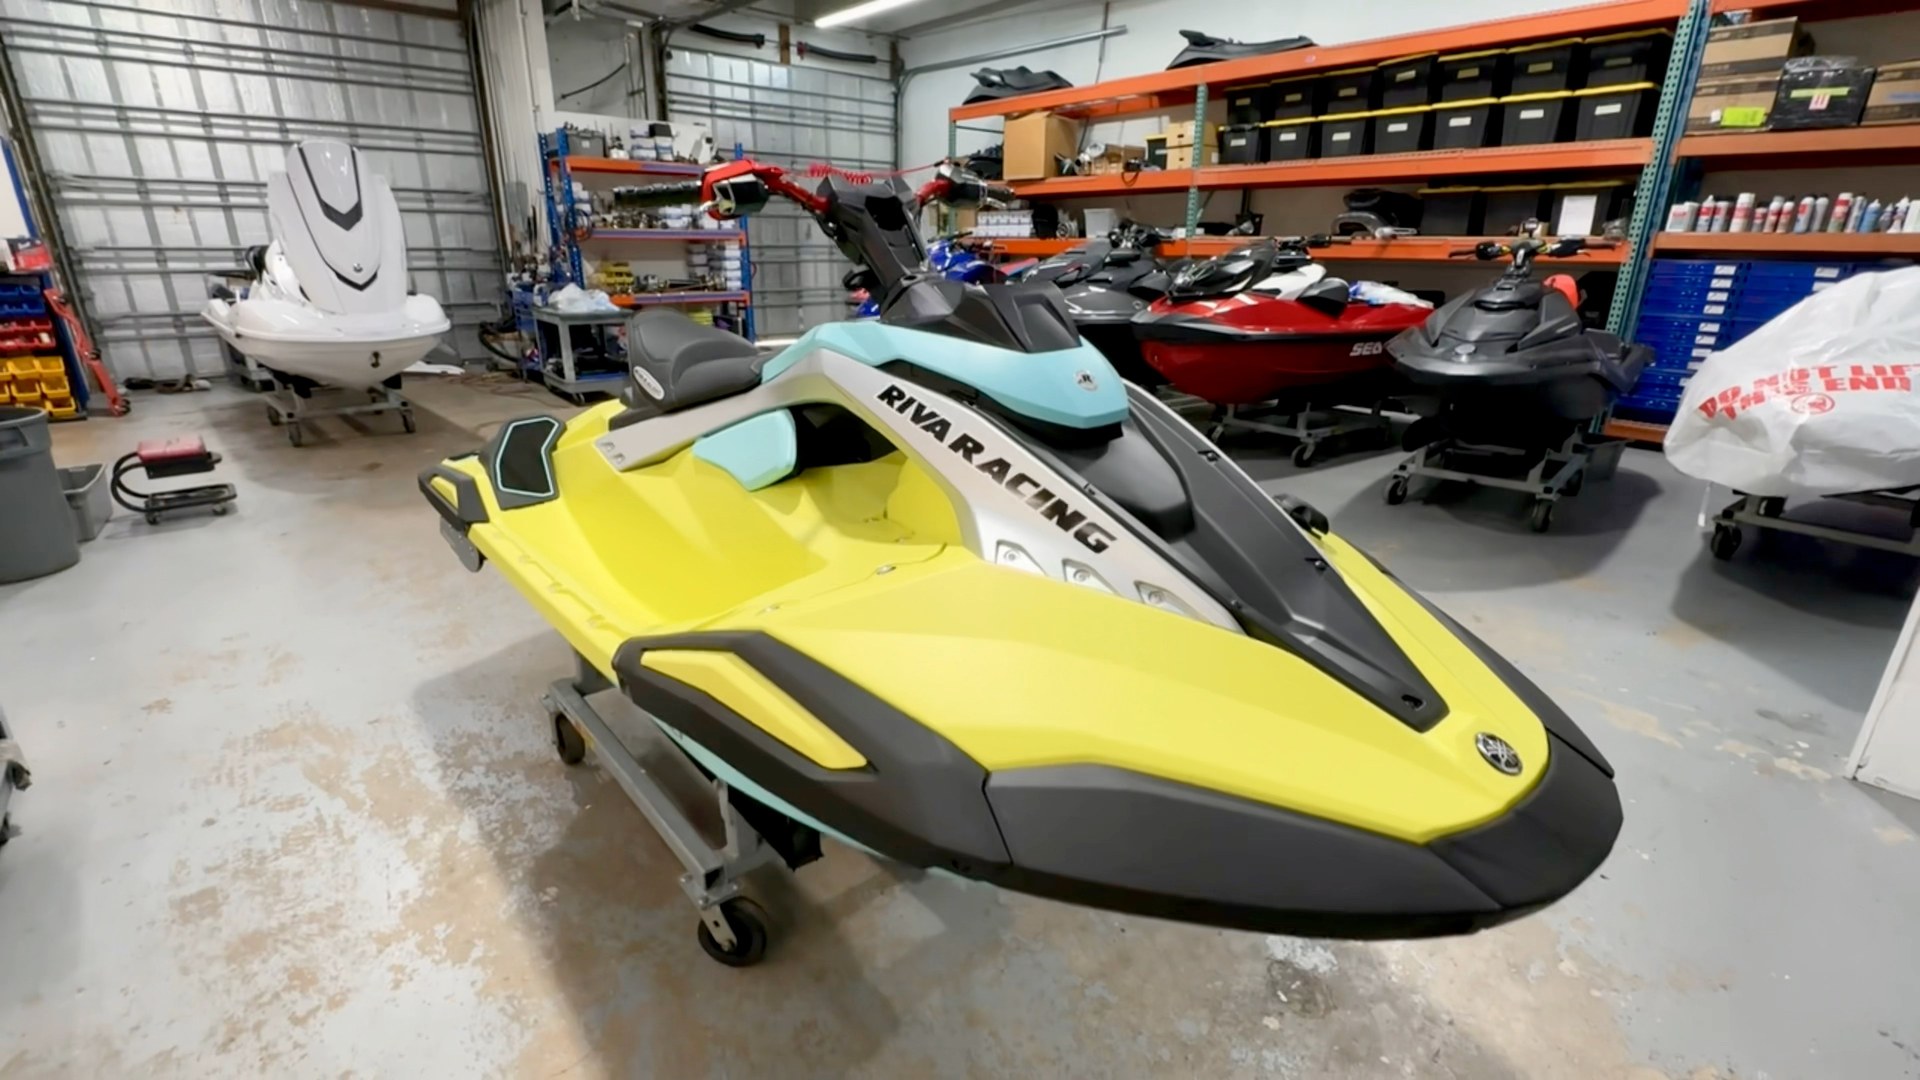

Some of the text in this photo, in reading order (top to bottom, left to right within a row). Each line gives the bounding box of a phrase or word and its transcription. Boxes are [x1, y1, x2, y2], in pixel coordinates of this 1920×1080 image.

[1698, 386, 1742, 419] DO
[1752, 365, 1839, 390] NOT
[1823, 376, 1912, 393] END
[877, 384, 1118, 554] RIVA RACING
